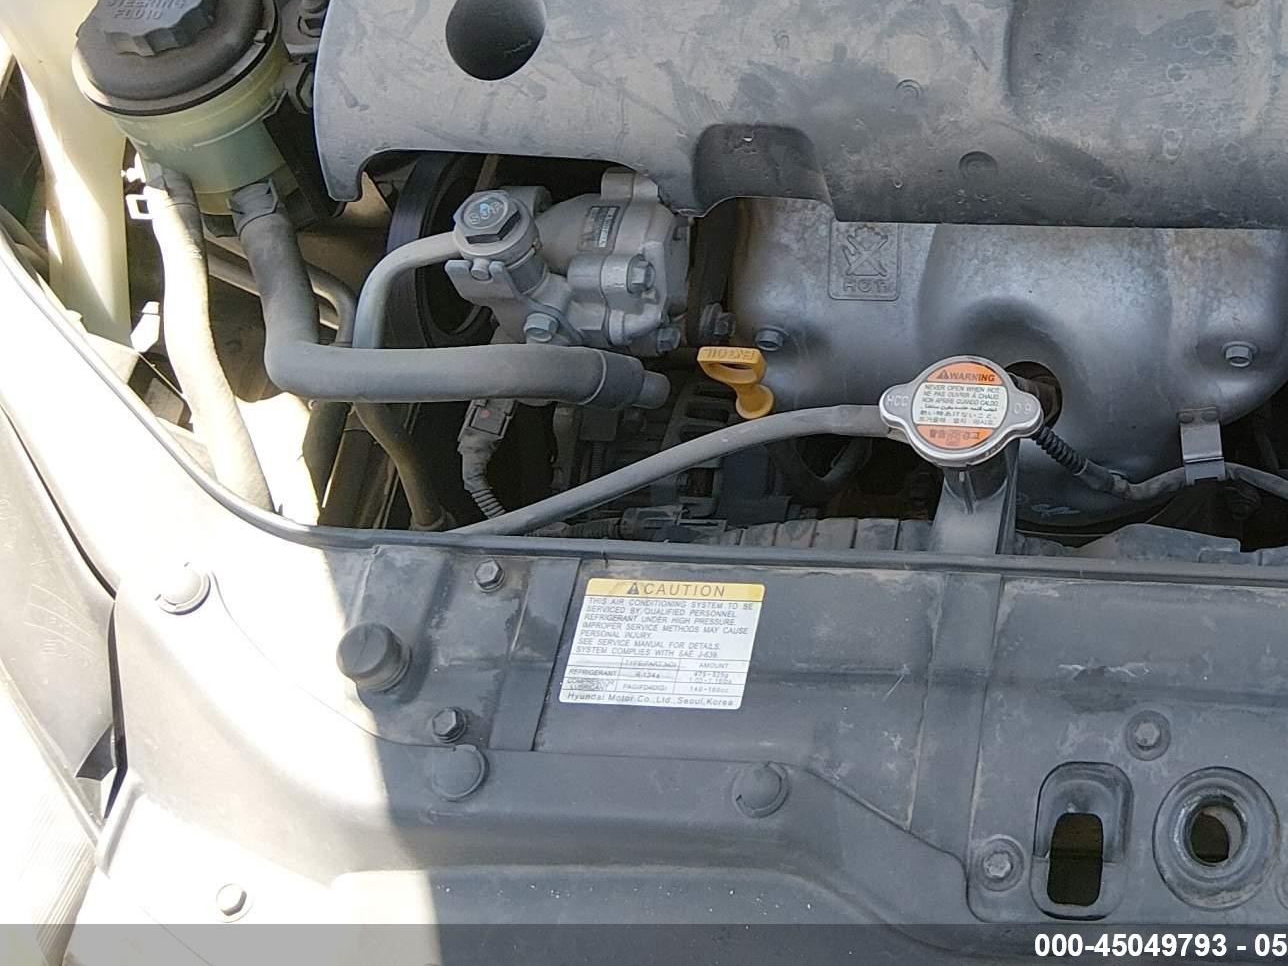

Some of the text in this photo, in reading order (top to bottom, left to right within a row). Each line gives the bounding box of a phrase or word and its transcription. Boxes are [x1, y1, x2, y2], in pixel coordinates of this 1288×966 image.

[114, 9, 163, 19] FLUID
[950, 372, 995, 382] WARNING
[886, 394, 909, 406] HCC
[643, 583, 725, 597] CAUTION
[630, 599, 687, 608] CONDITIONING
[586, 605, 626, 613] SERVICED
[690, 609, 736, 617] PERSONNEL
[584, 613, 637, 622] REFRIGERANT
[641, 615, 667, 623] UNDER
[582, 621, 622, 629] IMPROPER
[626, 623, 659, 631] SERVICE
[662, 624, 699, 632] METHODS
[580, 629, 620, 638] PERSONAL
[597, 638, 631, 646] SERVICE
[575, 646, 607, 654] SYSTEM
[612, 647, 650, 655] COMPLIES
[568, 668, 617, 676] REFRIGERANT
[567, 692, 605, 701] Hyundai
[609, 694, 634, 702] Motor
